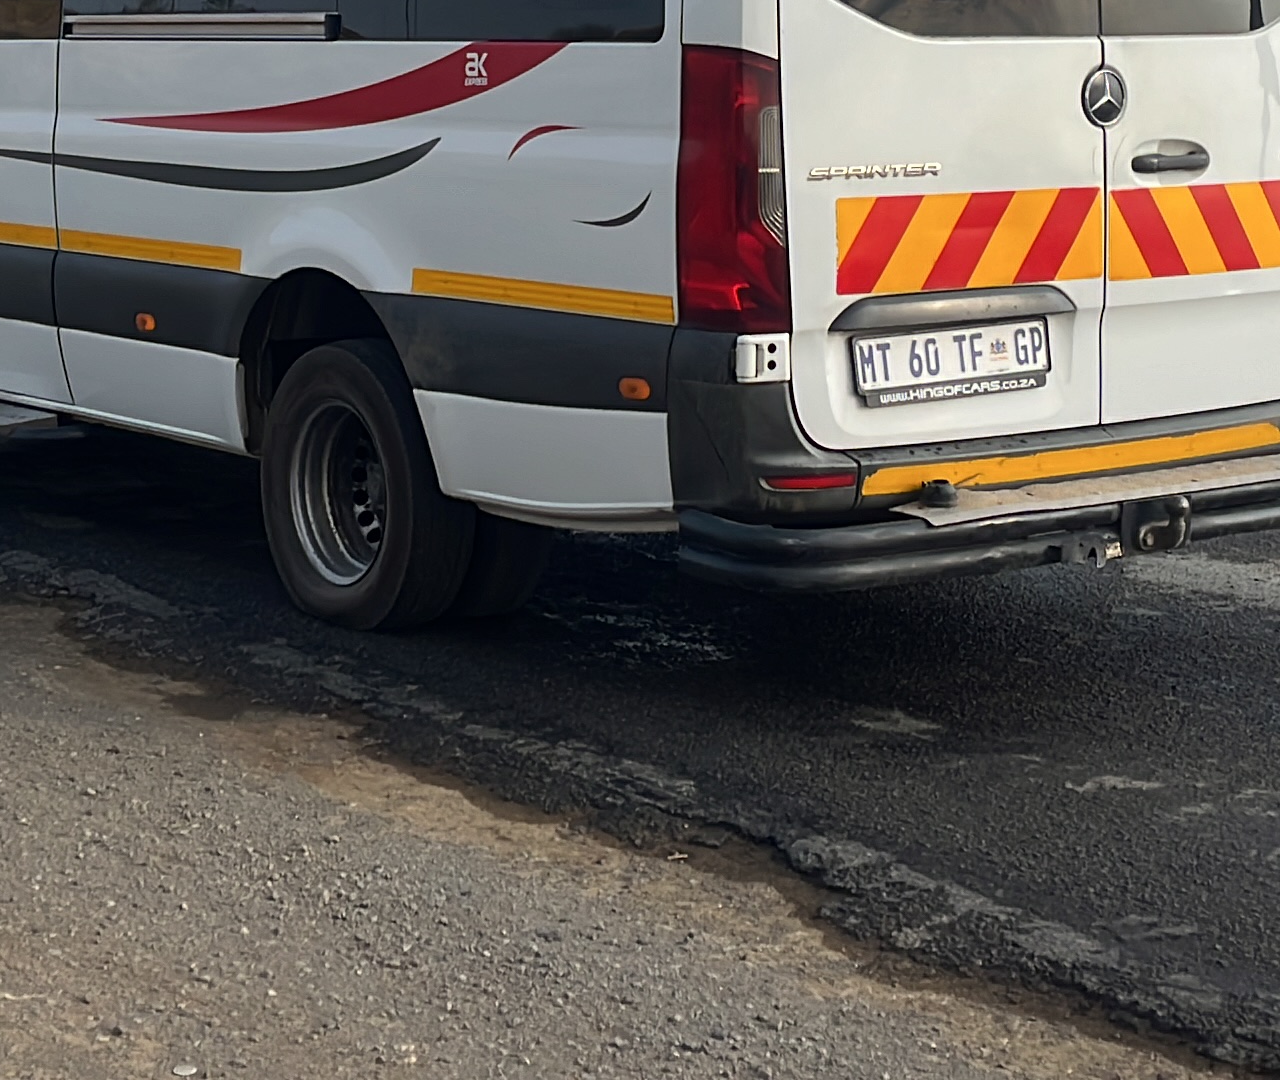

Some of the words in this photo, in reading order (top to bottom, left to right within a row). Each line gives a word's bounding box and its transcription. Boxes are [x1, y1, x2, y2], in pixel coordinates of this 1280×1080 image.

[807, 162, 942, 181] SPRINTER
[859, 342, 891, 384] MT
[909, 338, 940, 377] 60
[953, 333, 983, 372] TF
[1014, 327, 1042, 366] GP
